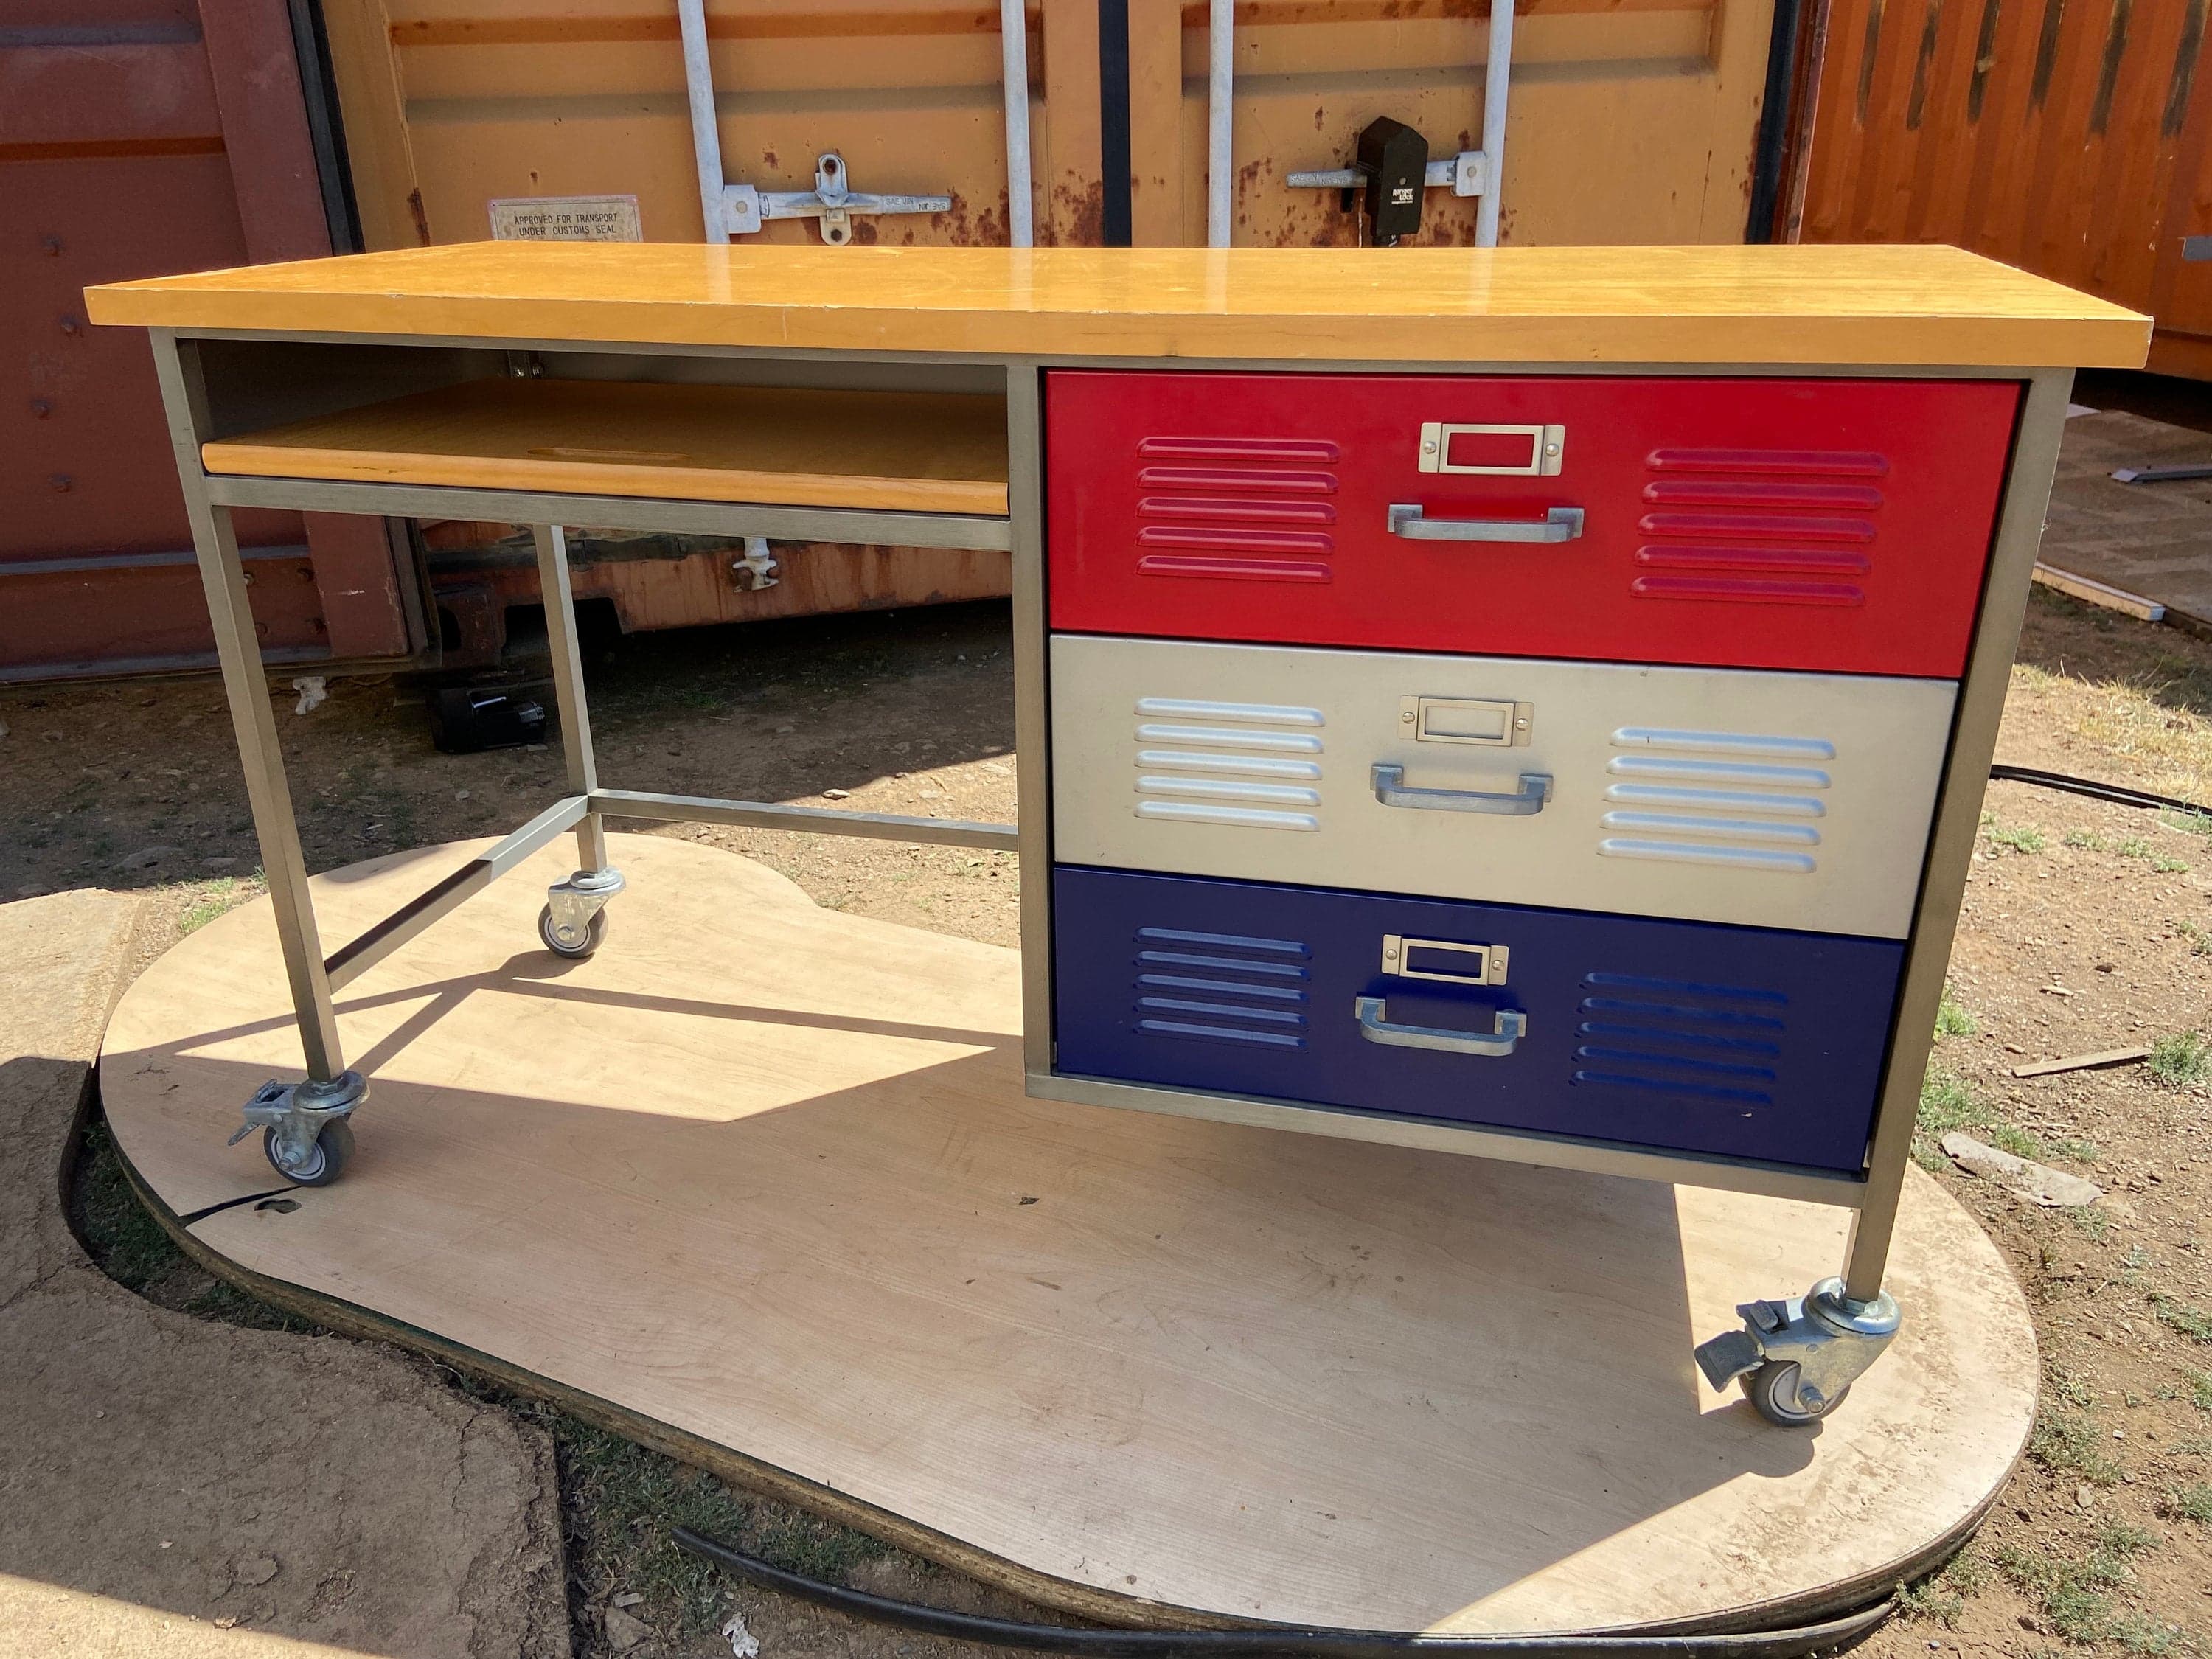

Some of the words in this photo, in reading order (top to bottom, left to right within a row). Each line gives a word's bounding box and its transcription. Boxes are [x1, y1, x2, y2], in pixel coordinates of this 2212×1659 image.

[515, 215, 553, 225] APPROVED
[557, 214, 572, 223] FOR
[575, 212, 618, 223] TRANSPORT
[519, 226, 546, 236] UNDER
[552, 225, 590, 235] CUSTOMS
[596, 224, 617, 234] SEAL
